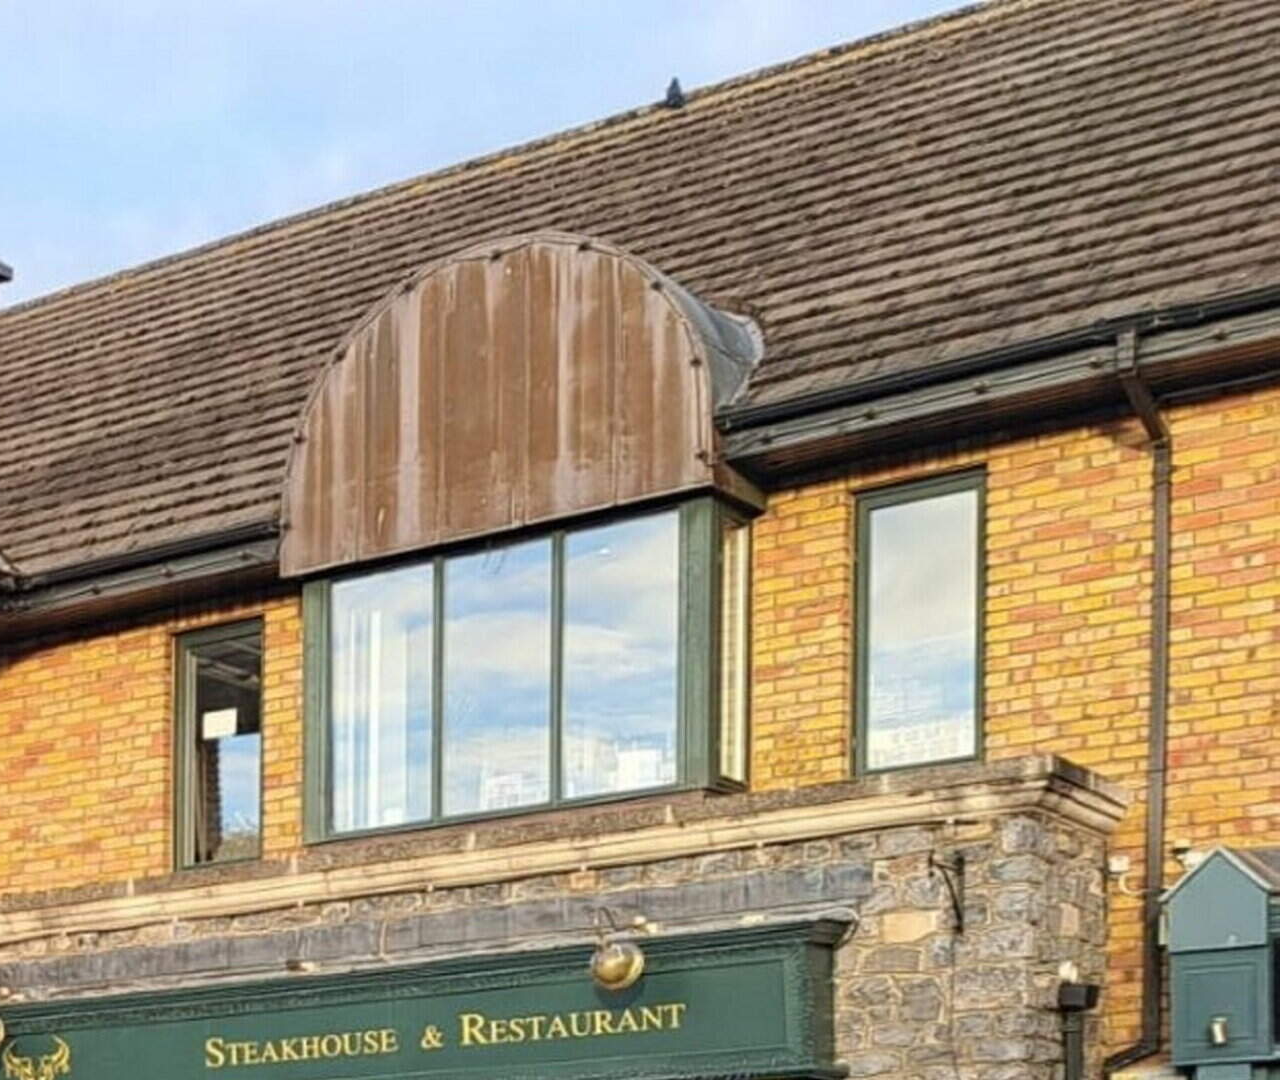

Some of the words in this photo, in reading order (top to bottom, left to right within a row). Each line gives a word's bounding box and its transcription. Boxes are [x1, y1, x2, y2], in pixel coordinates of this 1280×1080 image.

[205, 1028, 399, 1068] STEAKHOUSE
[420, 1025, 444, 1049] &
[459, 1003, 686, 1046] RESTAURANT
